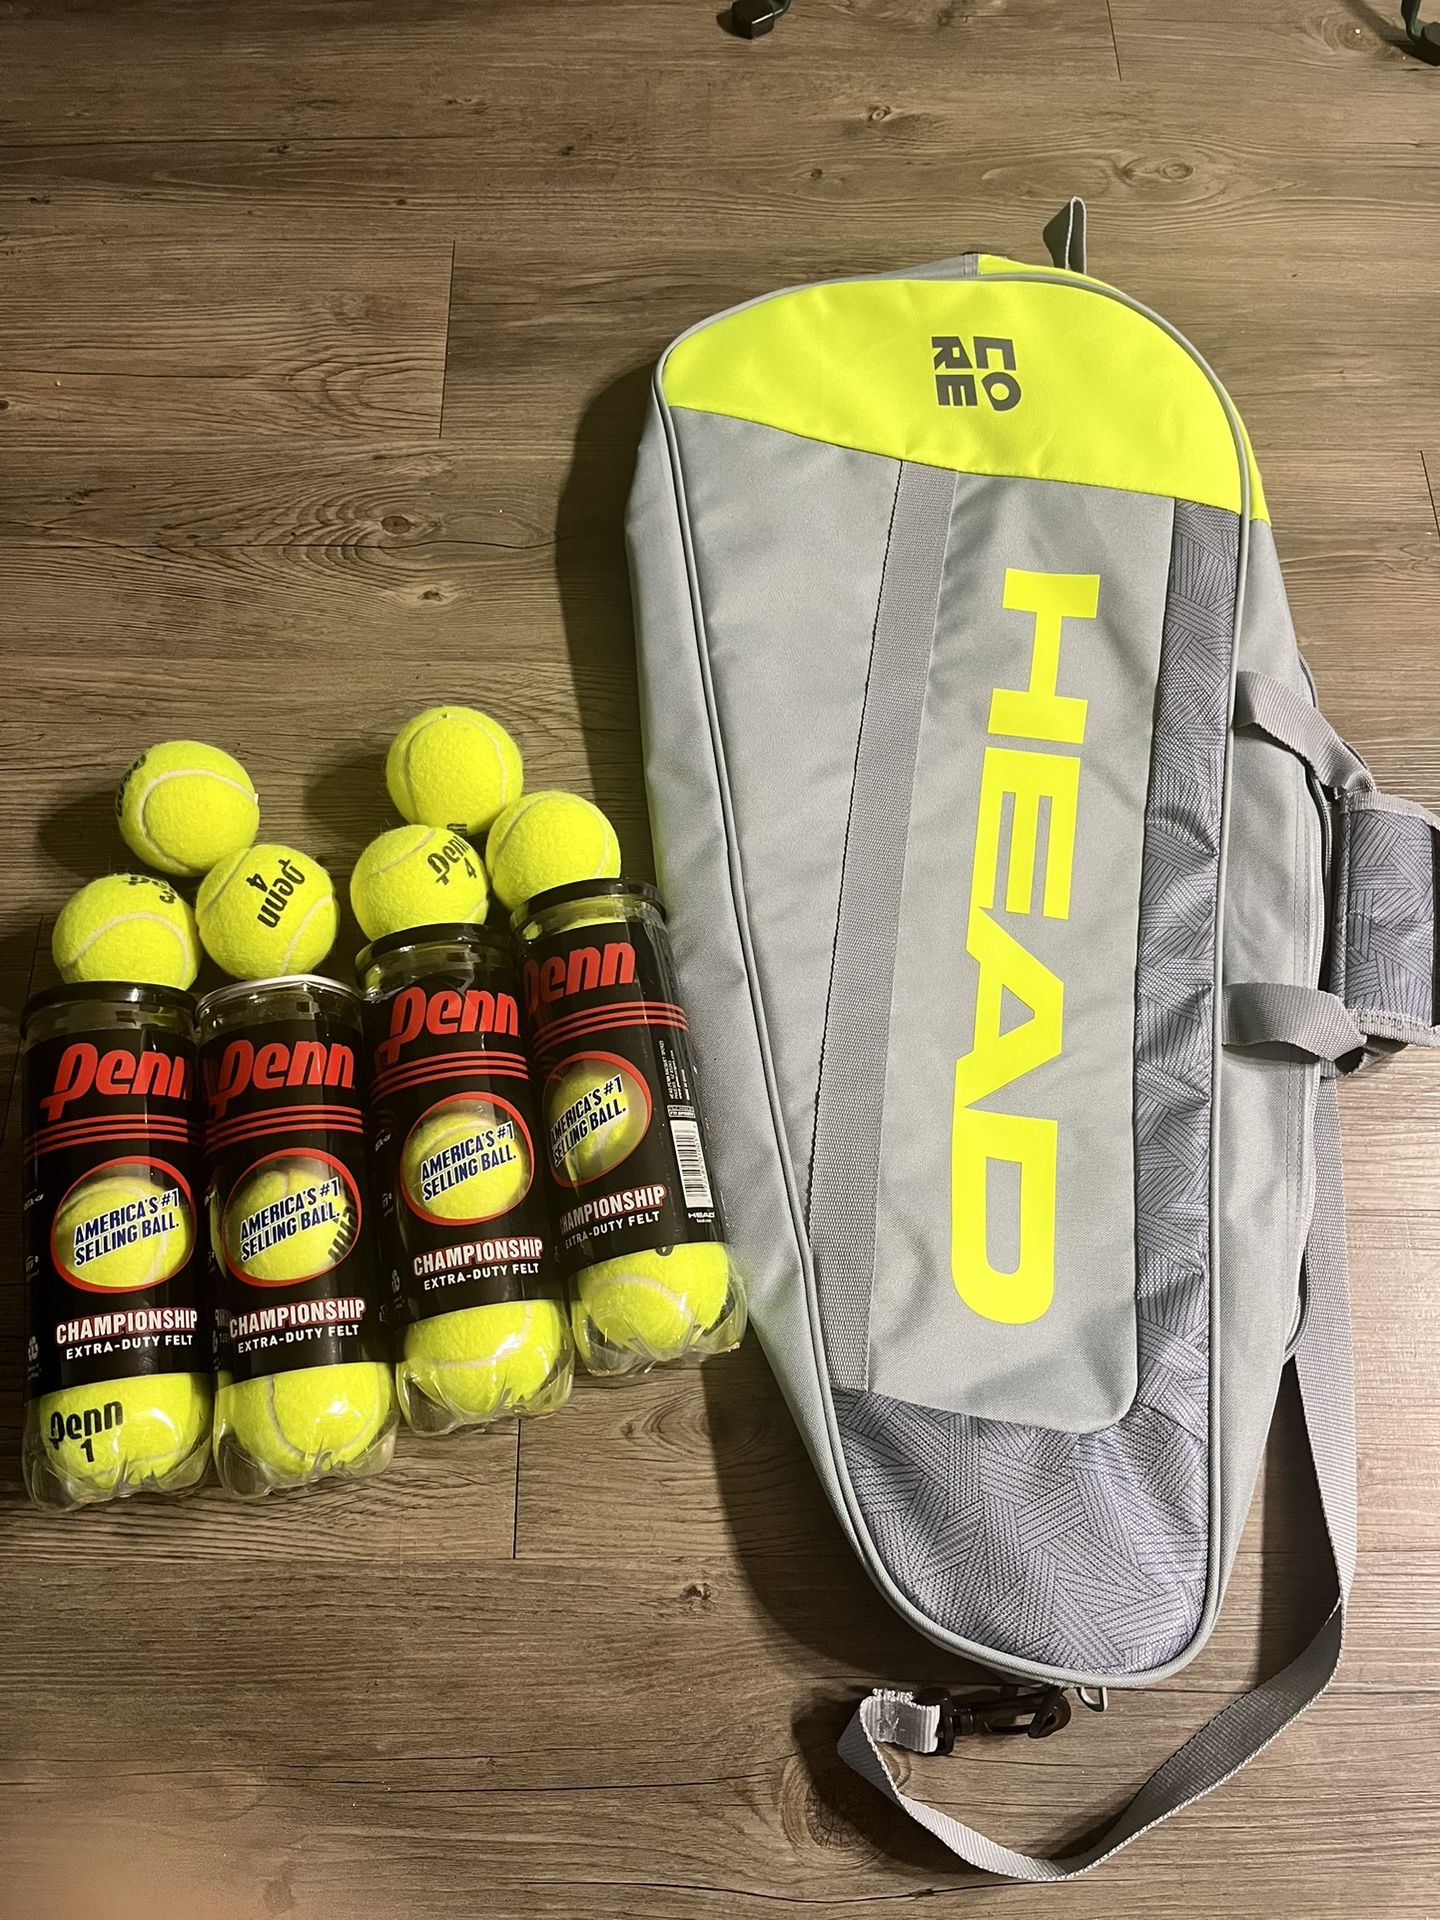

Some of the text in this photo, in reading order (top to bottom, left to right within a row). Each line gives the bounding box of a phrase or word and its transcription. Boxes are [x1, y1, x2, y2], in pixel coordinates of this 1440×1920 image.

[246, 873, 268, 893] 4
[464, 857, 477, 878] 4
[257, 859, 305, 928] Penn
[950, 567, 1100, 1324] HEAD
[378, 986, 519, 1064] Penn
[211, 1040, 355, 1119] Penn
[603, 1076, 623, 1096] #1
[589, 1099, 626, 1131] BALL.
[422, 1130, 495, 1182] AMERICA'S
[497, 1123, 513, 1140] #1
[423, 1144, 517, 1201] SELLING BALL.
[75, 1190, 179, 1246] AMERICA'S #1
[241, 1180, 338, 1241] AMERICA'S #1
[628, 1211, 660, 1227] FELT
[75, 1212, 179, 1266] SELLING BALL.
[242, 1217, 297, 1261] SELLING
[301, 1202, 340, 1231] BALL.
[413, 1239, 543, 1277] CHAMPIONSHIP
[423, 1263, 540, 1291] EXTRA-DUTY FELT
[56, 1309, 198, 1345] CHAMPIONSHIP
[229, 1299, 366, 1338] CHAMPIONSHIP
[66, 1334, 193, 1360] EXTRA-DUTY FELT
[238, 1324, 360, 1354] EXTRA-DUTY FELT
[49, 1400, 124, 1450] Penn
[80, 1438, 95, 1463] 1
